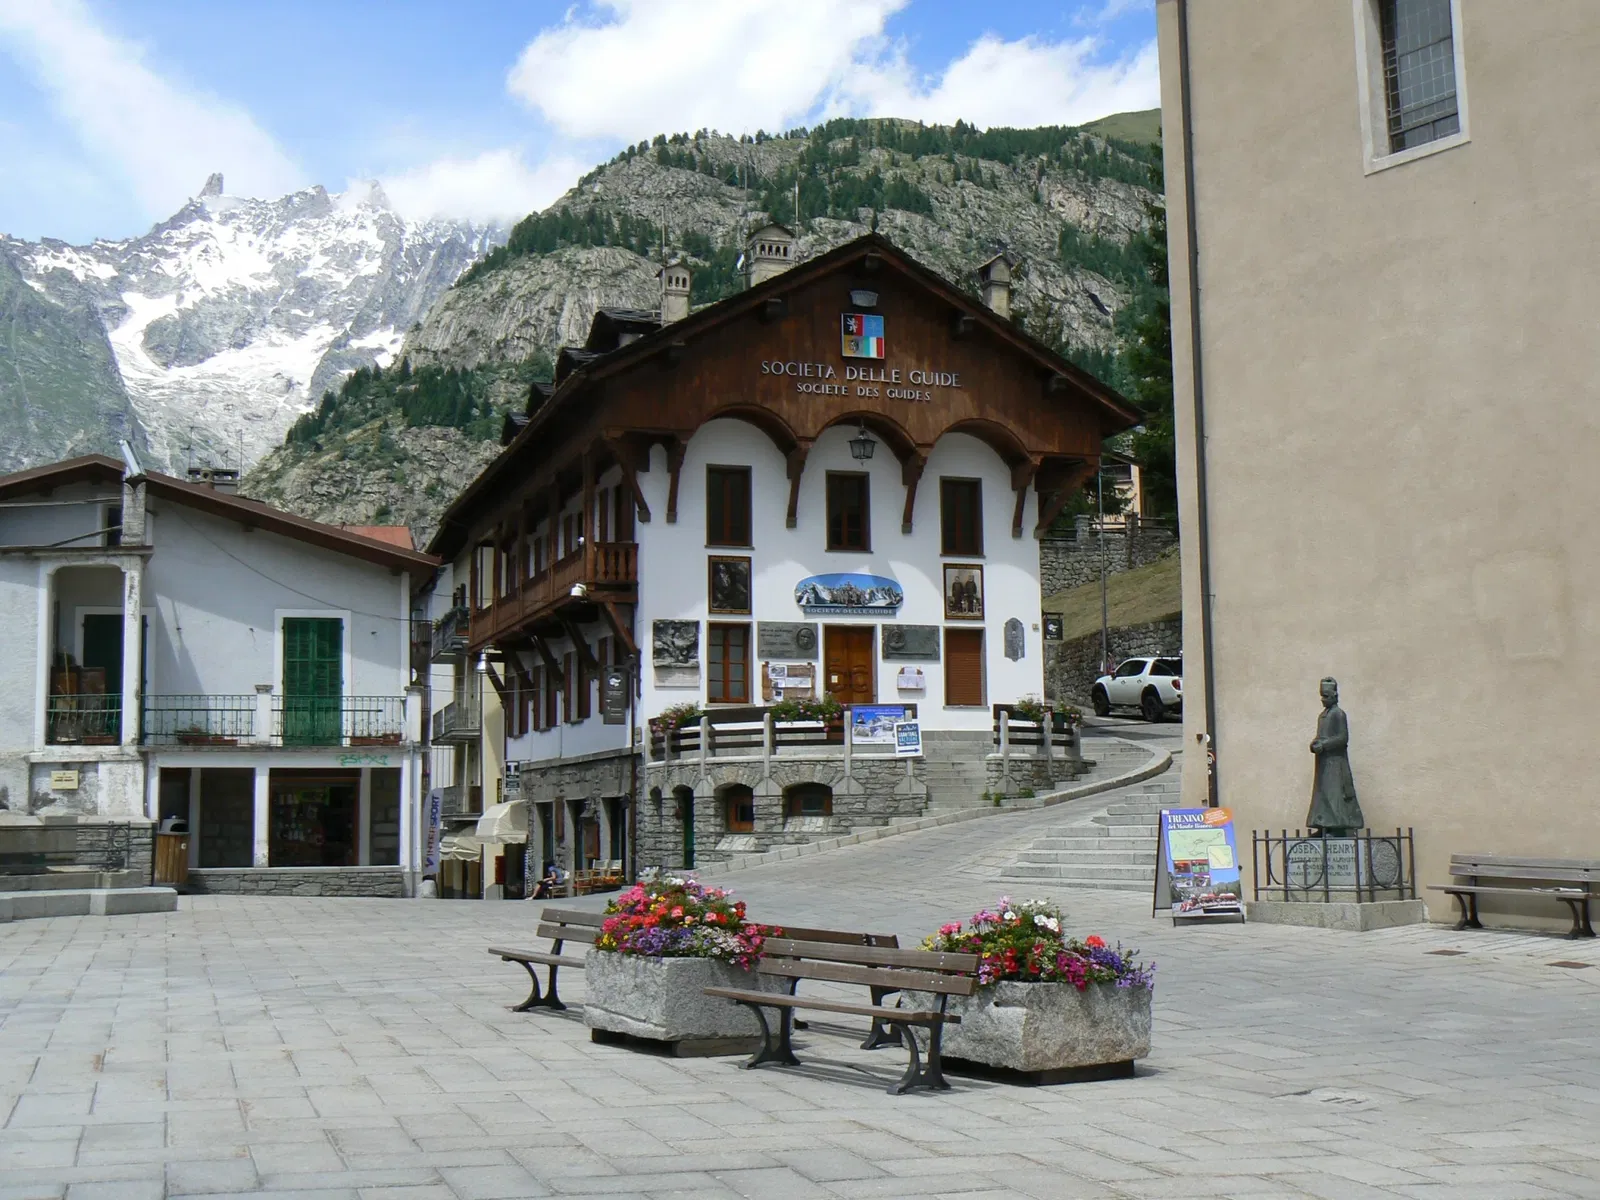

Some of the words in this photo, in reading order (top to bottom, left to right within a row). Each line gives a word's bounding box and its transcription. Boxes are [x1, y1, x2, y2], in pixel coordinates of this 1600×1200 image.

[761, 360, 837, 379] SOCIETA
[846, 366, 902, 383] DELLE
[909, 370, 962, 387] GUIDE
[796, 382, 849, 396] SOCIETE
[857, 386, 880, 397] DES
[886, 389, 931, 401] GUIDES
[426, 794, 440, 856] INTERSPORT
[1167, 814, 1204, 823] TRENINO
